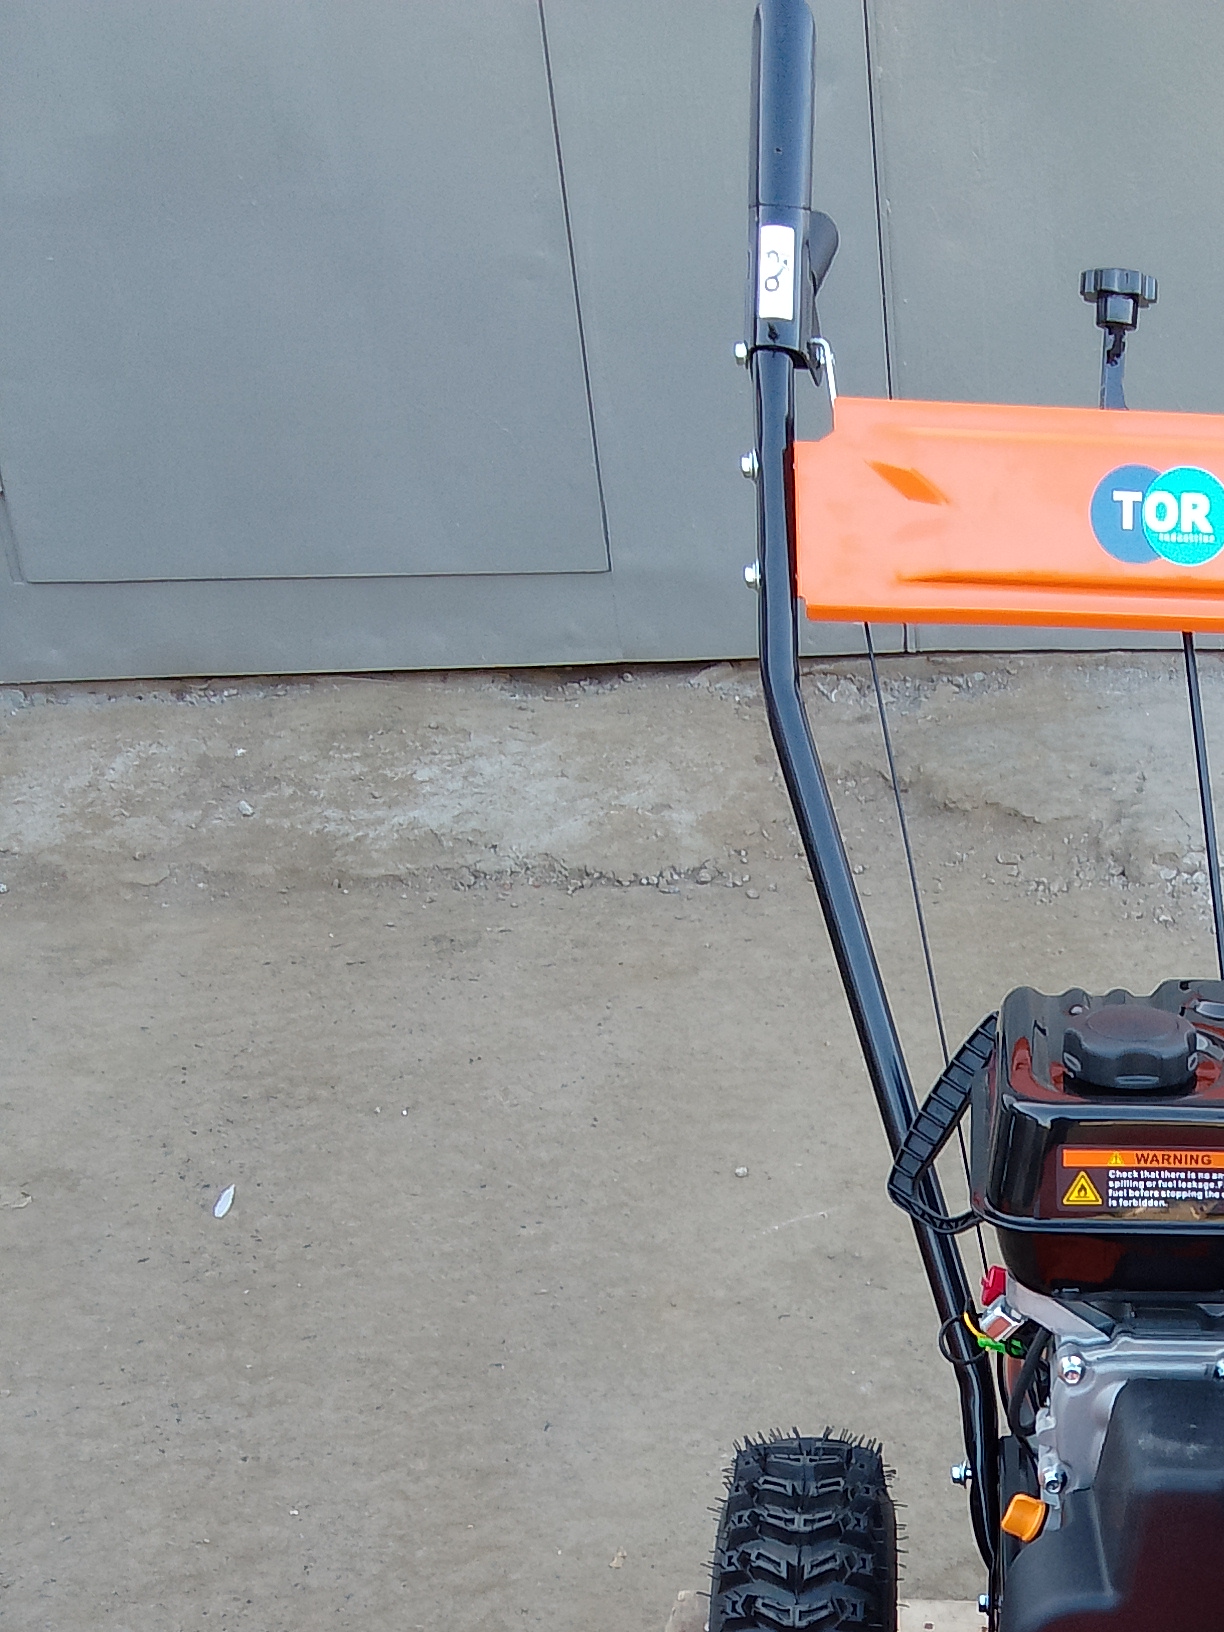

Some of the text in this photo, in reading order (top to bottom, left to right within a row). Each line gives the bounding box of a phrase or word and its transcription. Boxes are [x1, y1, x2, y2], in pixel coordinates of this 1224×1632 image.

[1112, 490, 1214, 533] TOR
[1135, 1152, 1212, 1166] WARNING
[1108, 1169, 1139, 1179] Check
[1140, 1170, 1160, 1179] that
[1160, 1170, 1186, 1179] there
[1187, 1171, 1196, 1179] is
[1197, 1172, 1210, 1180] no
[1108, 1180, 1145, 1189] spilling
[1145, 1180, 1157, 1188] or
[1158, 1180, 1177, 1188] fuel
[1108, 1188, 1128, 1197] fuel
[1128, 1188, 1160, 1198] before
[1160, 1189, 1203, 1200] stopping
[1204, 1189, 1220, 1199] the
[1108, 1198, 1169, 1208] is forbidden.
